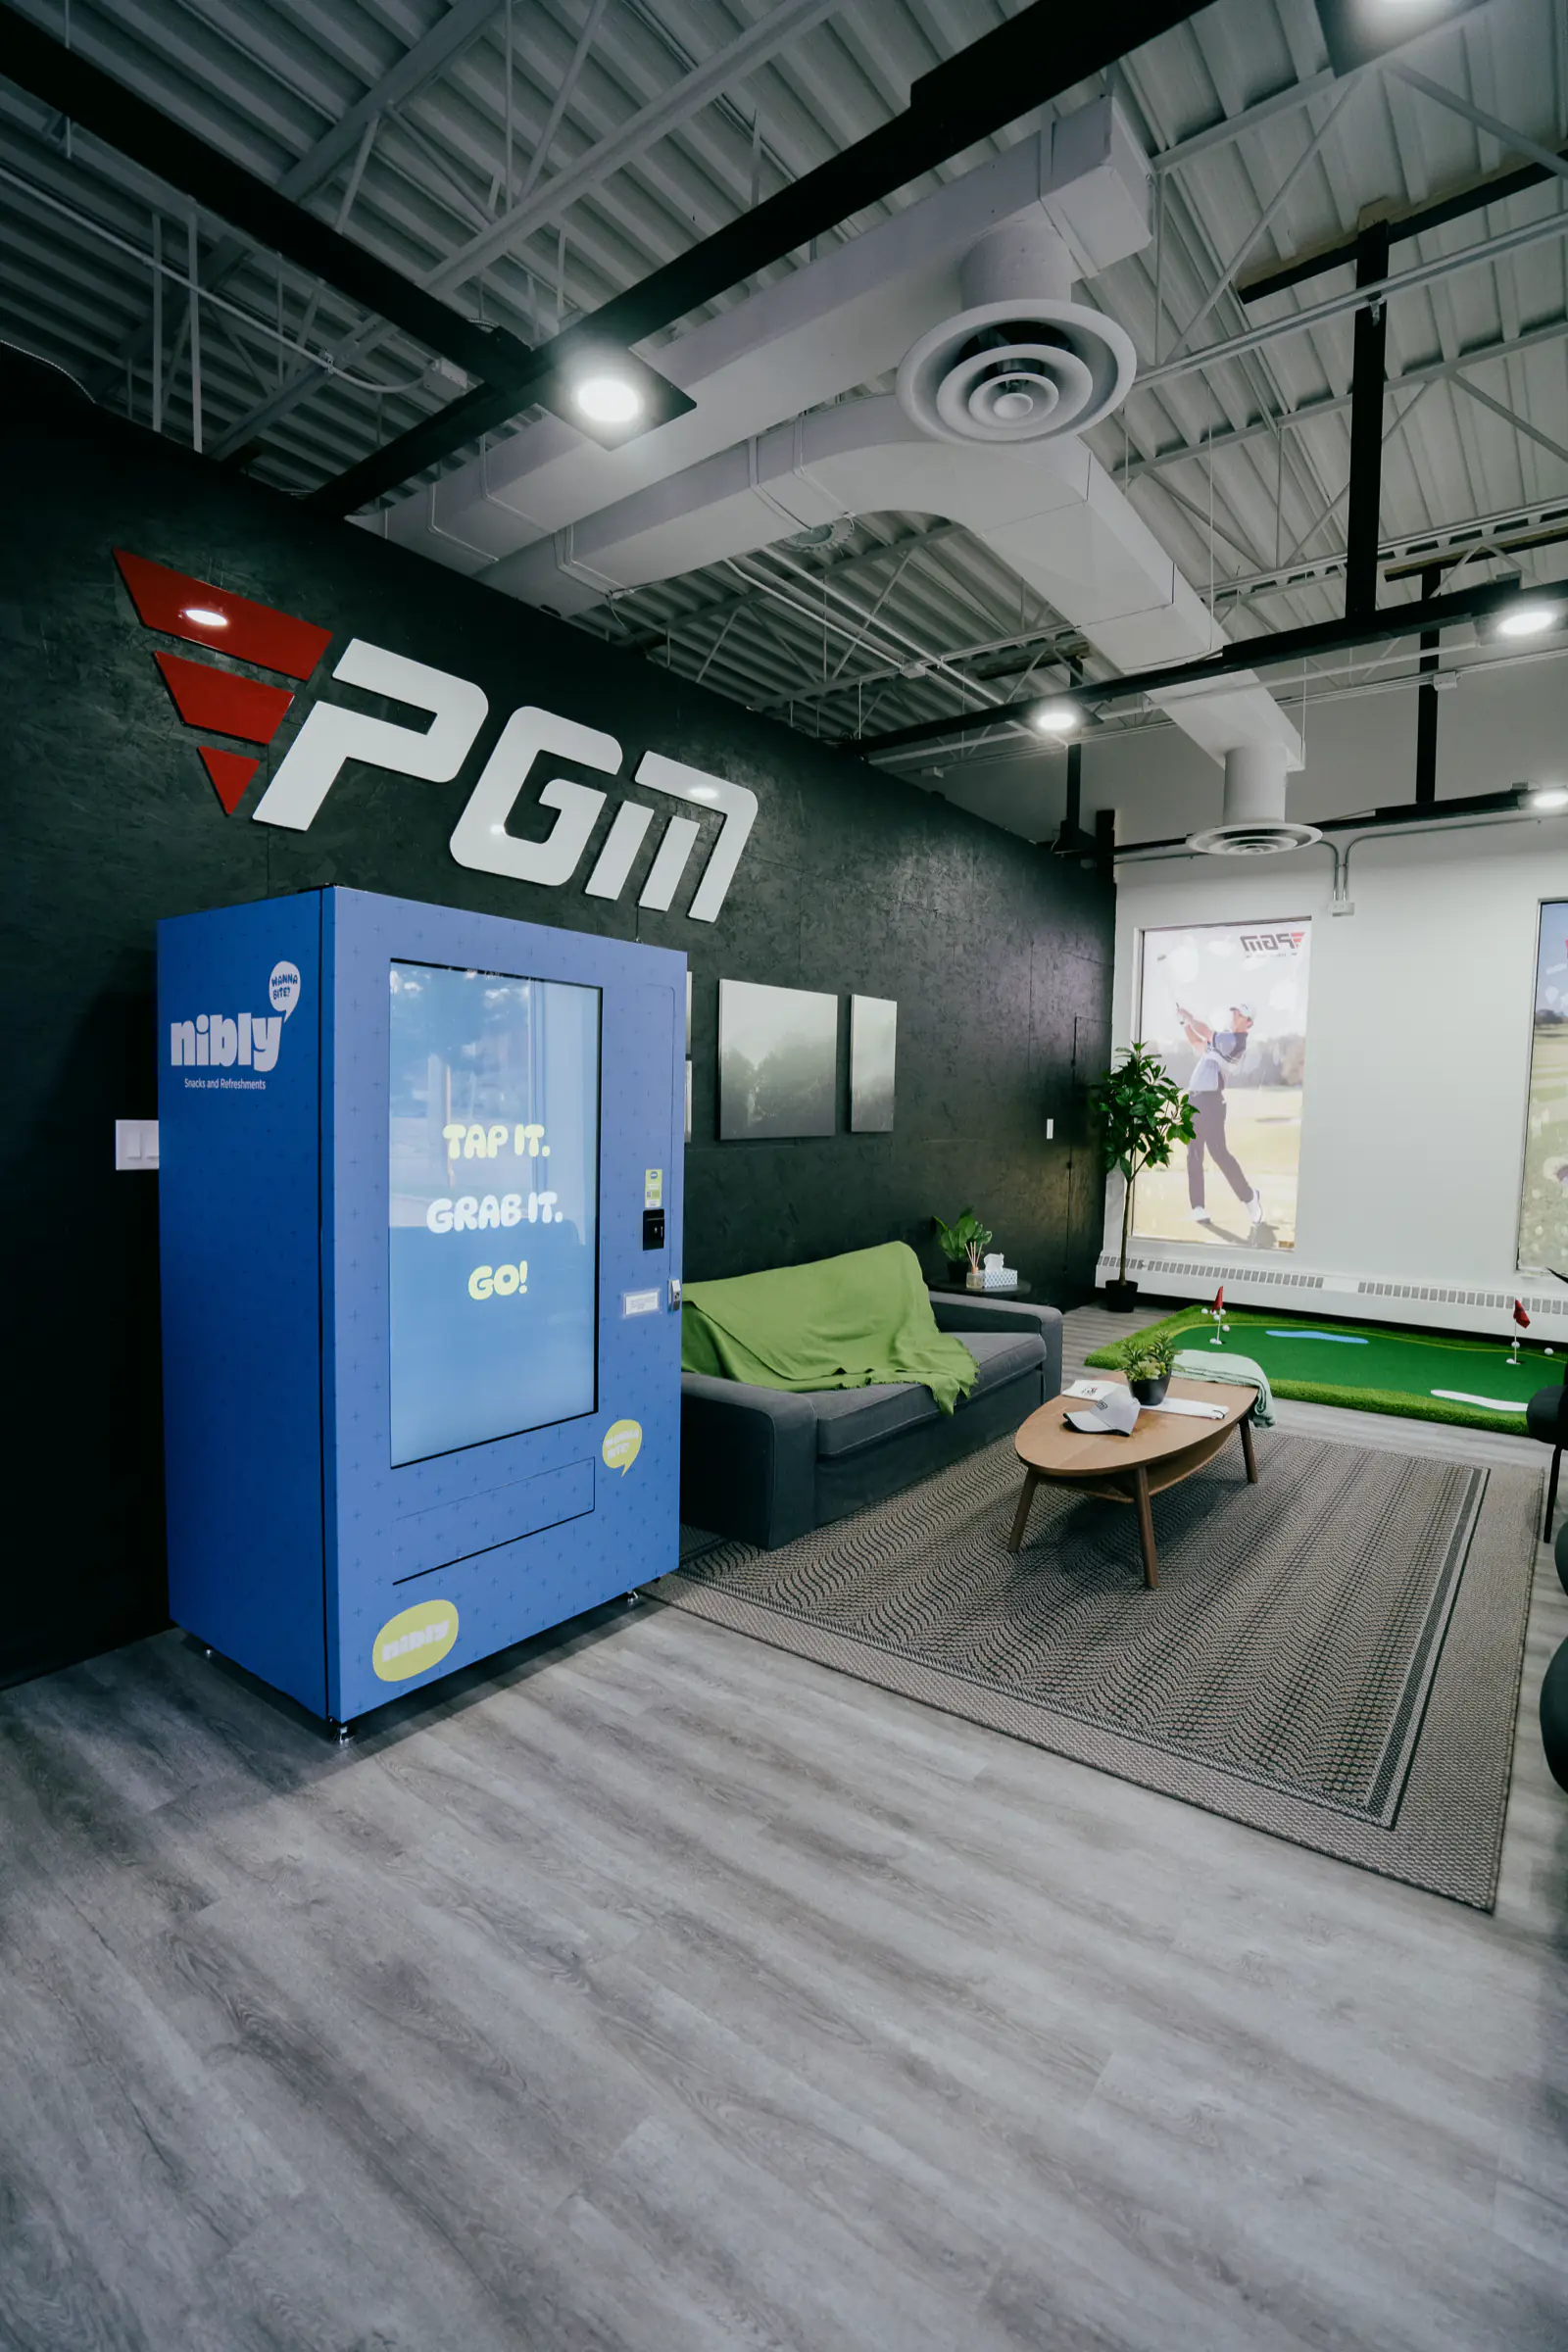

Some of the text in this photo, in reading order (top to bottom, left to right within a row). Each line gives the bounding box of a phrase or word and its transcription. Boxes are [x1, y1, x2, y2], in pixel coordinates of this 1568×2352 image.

[253, 638, 758, 923] PGM
[271, 973, 298, 987] WANNA
[273, 987, 290, 1000] BITE?
[171, 1012, 282, 1072] nibly
[184, 1078, 267, 1090] Snacks and Refreshments
[443, 1124, 551, 1159] TAP IT.
[426, 1192, 564, 1234] GRAB IT.
[468, 1260, 527, 1300] GO!
